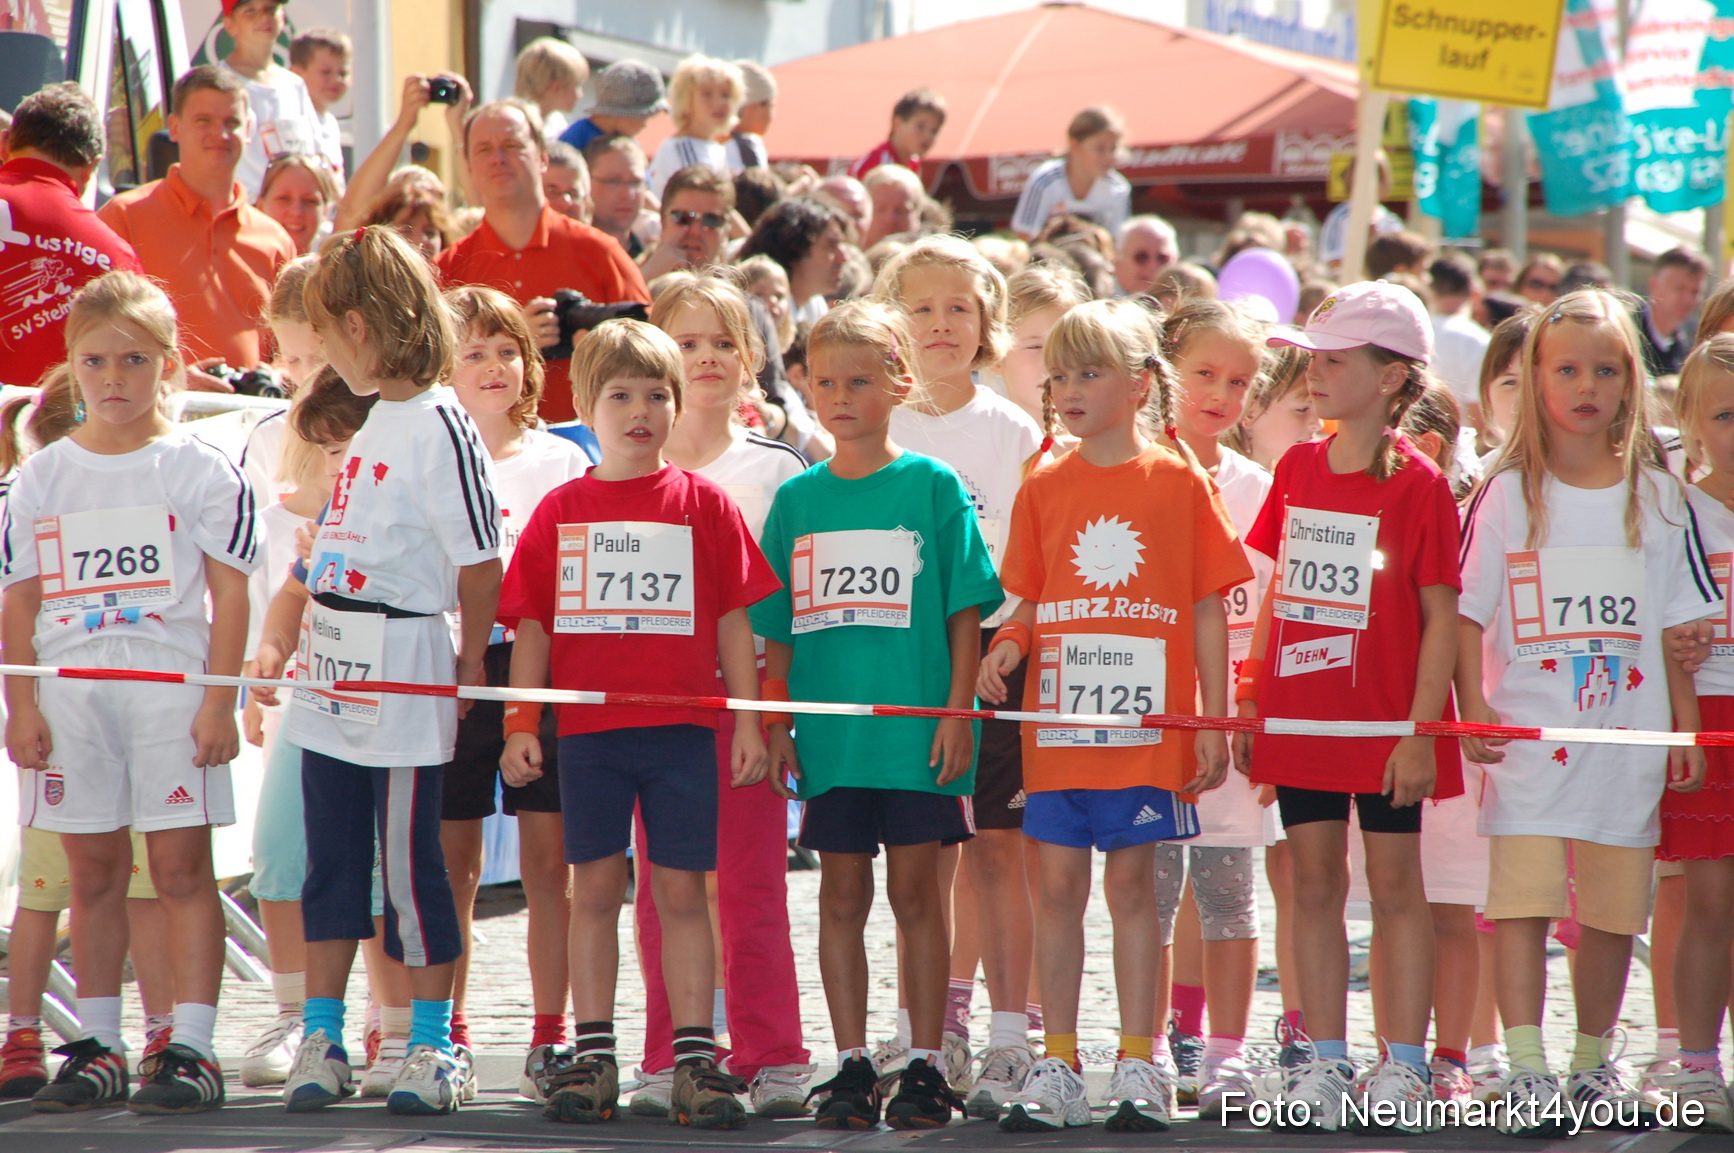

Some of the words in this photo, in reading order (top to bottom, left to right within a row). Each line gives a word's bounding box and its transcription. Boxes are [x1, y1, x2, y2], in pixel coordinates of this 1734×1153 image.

[1392, 4, 1547, 42] Schnupper-
[1438, 43, 1490, 71] lauf
[11, 319, 32, 340] SV
[594, 532, 640, 552] Paula
[1290, 517, 1355, 546] Christina
[72, 544, 160, 581] 7268
[596, 571, 682, 602] 7137
[820, 566, 900, 598] 7230
[1288, 558, 1359, 596] 7033
[118, 587, 172, 600] PFLEIDERER
[857, 609, 908, 620] PFLEIDERER
[1036, 597, 1110, 624] MERZ
[1316, 607, 1366, 621] PFLEIDERER
[1552, 595, 1637, 626] 7182
[312, 612, 341, 641] Melina
[557, 616, 608, 627] BOCK
[641, 616, 691, 627] PFLEIDERER
[1066, 645, 1133, 666] Marlene
[1295, 647, 1329, 665] DEHN
[1517, 641, 1571, 656] BOCK
[314, 652, 371, 681] 7077
[341, 702, 378, 716] PFLEIDERER
[1068, 685, 1153, 715] 7125
[1038, 729, 1079, 741] BOCK
[1110, 729, 1160, 740] PFLEIDERER
[164, 796, 195, 805] adidas
[1132, 813, 1163, 826] adidas
